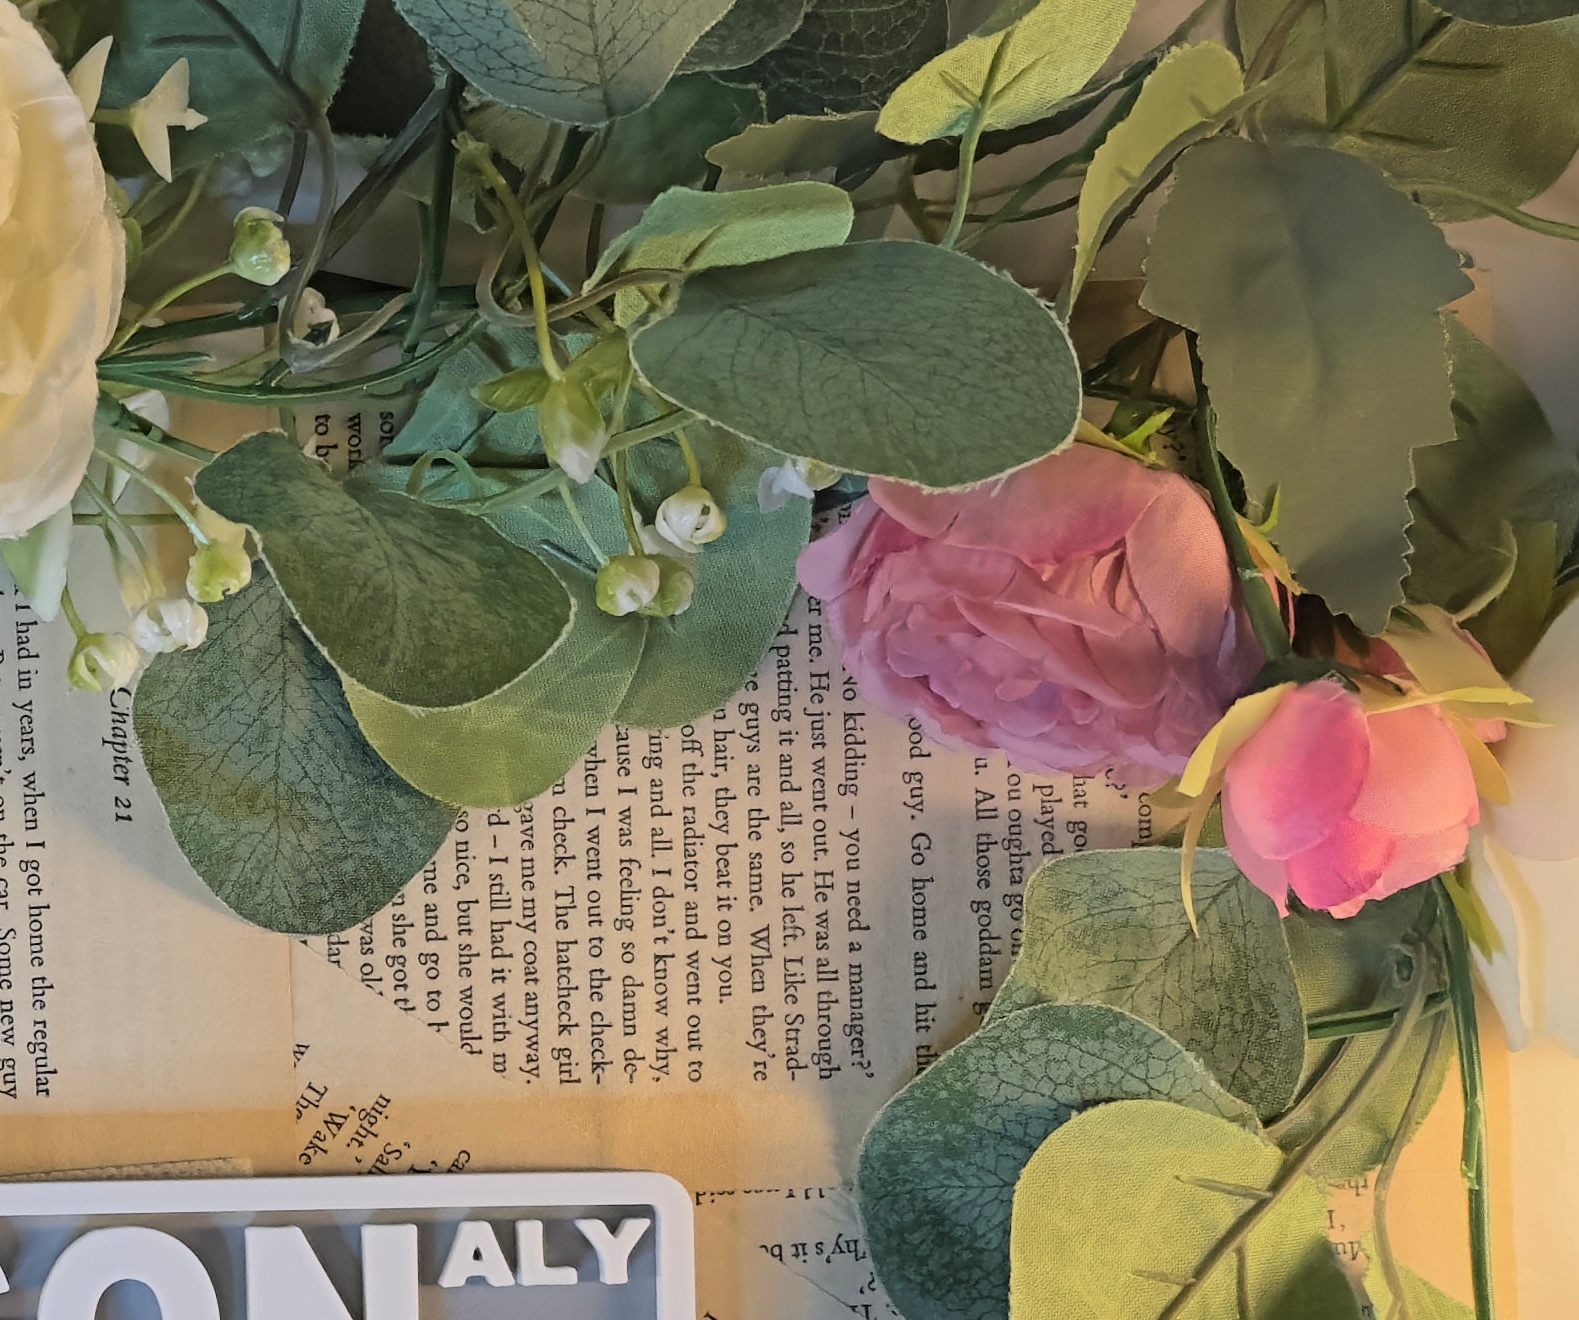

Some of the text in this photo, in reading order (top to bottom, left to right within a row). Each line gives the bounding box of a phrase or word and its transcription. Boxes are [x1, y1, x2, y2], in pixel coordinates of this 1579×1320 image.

[15, 620, 39, 660] had
[17, 668, 38, 691] in
[11, 699, 34, 761] years,
[101, 686, 133, 822] Chapter 21
[22, 769, 45, 832] when
[25, 840, 45, 849] I
[802, 669, 841, 1080] He just went out. He was all through
[18, 859, 43, 896] got
[680, 724, 707, 1083] off the radiator and went out to
[737, 702, 775, 1081] guys are the same. When they're
[969, 787, 1002, 991] All those goddam
[27, 903, 50, 967] home
[550, 806, 581, 1085] check. The hatcheck girl
[0, 999, 14, 1047] new
[30, 976, 54, 1010] the
[26, 1019, 58, 1098] regular
[438, 1218, 651, 1288] ALY
